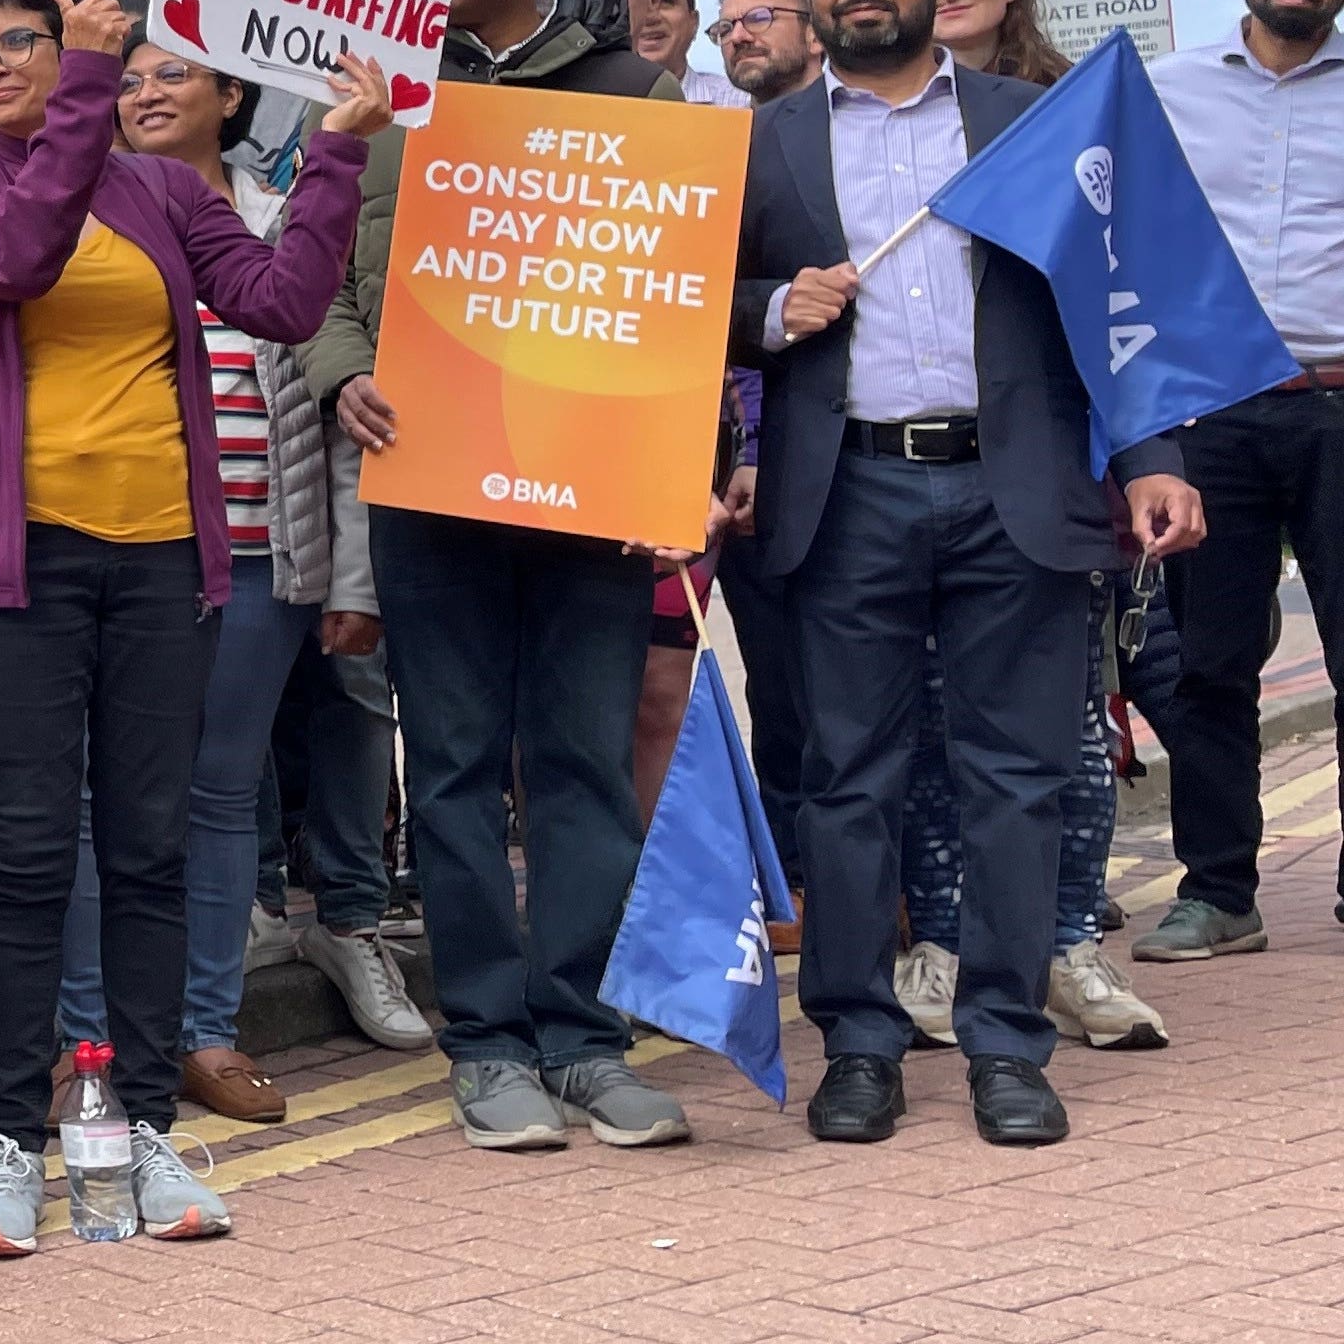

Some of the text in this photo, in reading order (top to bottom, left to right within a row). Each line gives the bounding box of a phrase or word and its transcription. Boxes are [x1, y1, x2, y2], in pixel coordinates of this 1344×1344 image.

[241, 8, 349, 73] NOW
[524, 126, 626, 166] #FIX
[425, 159, 718, 219] CONSULTANT
[467, 207, 662, 257] PAY NOW
[412, 245, 706, 307] AND FOR THE
[464, 293, 641, 345] FUTURE
[512, 479, 578, 510] BMA
